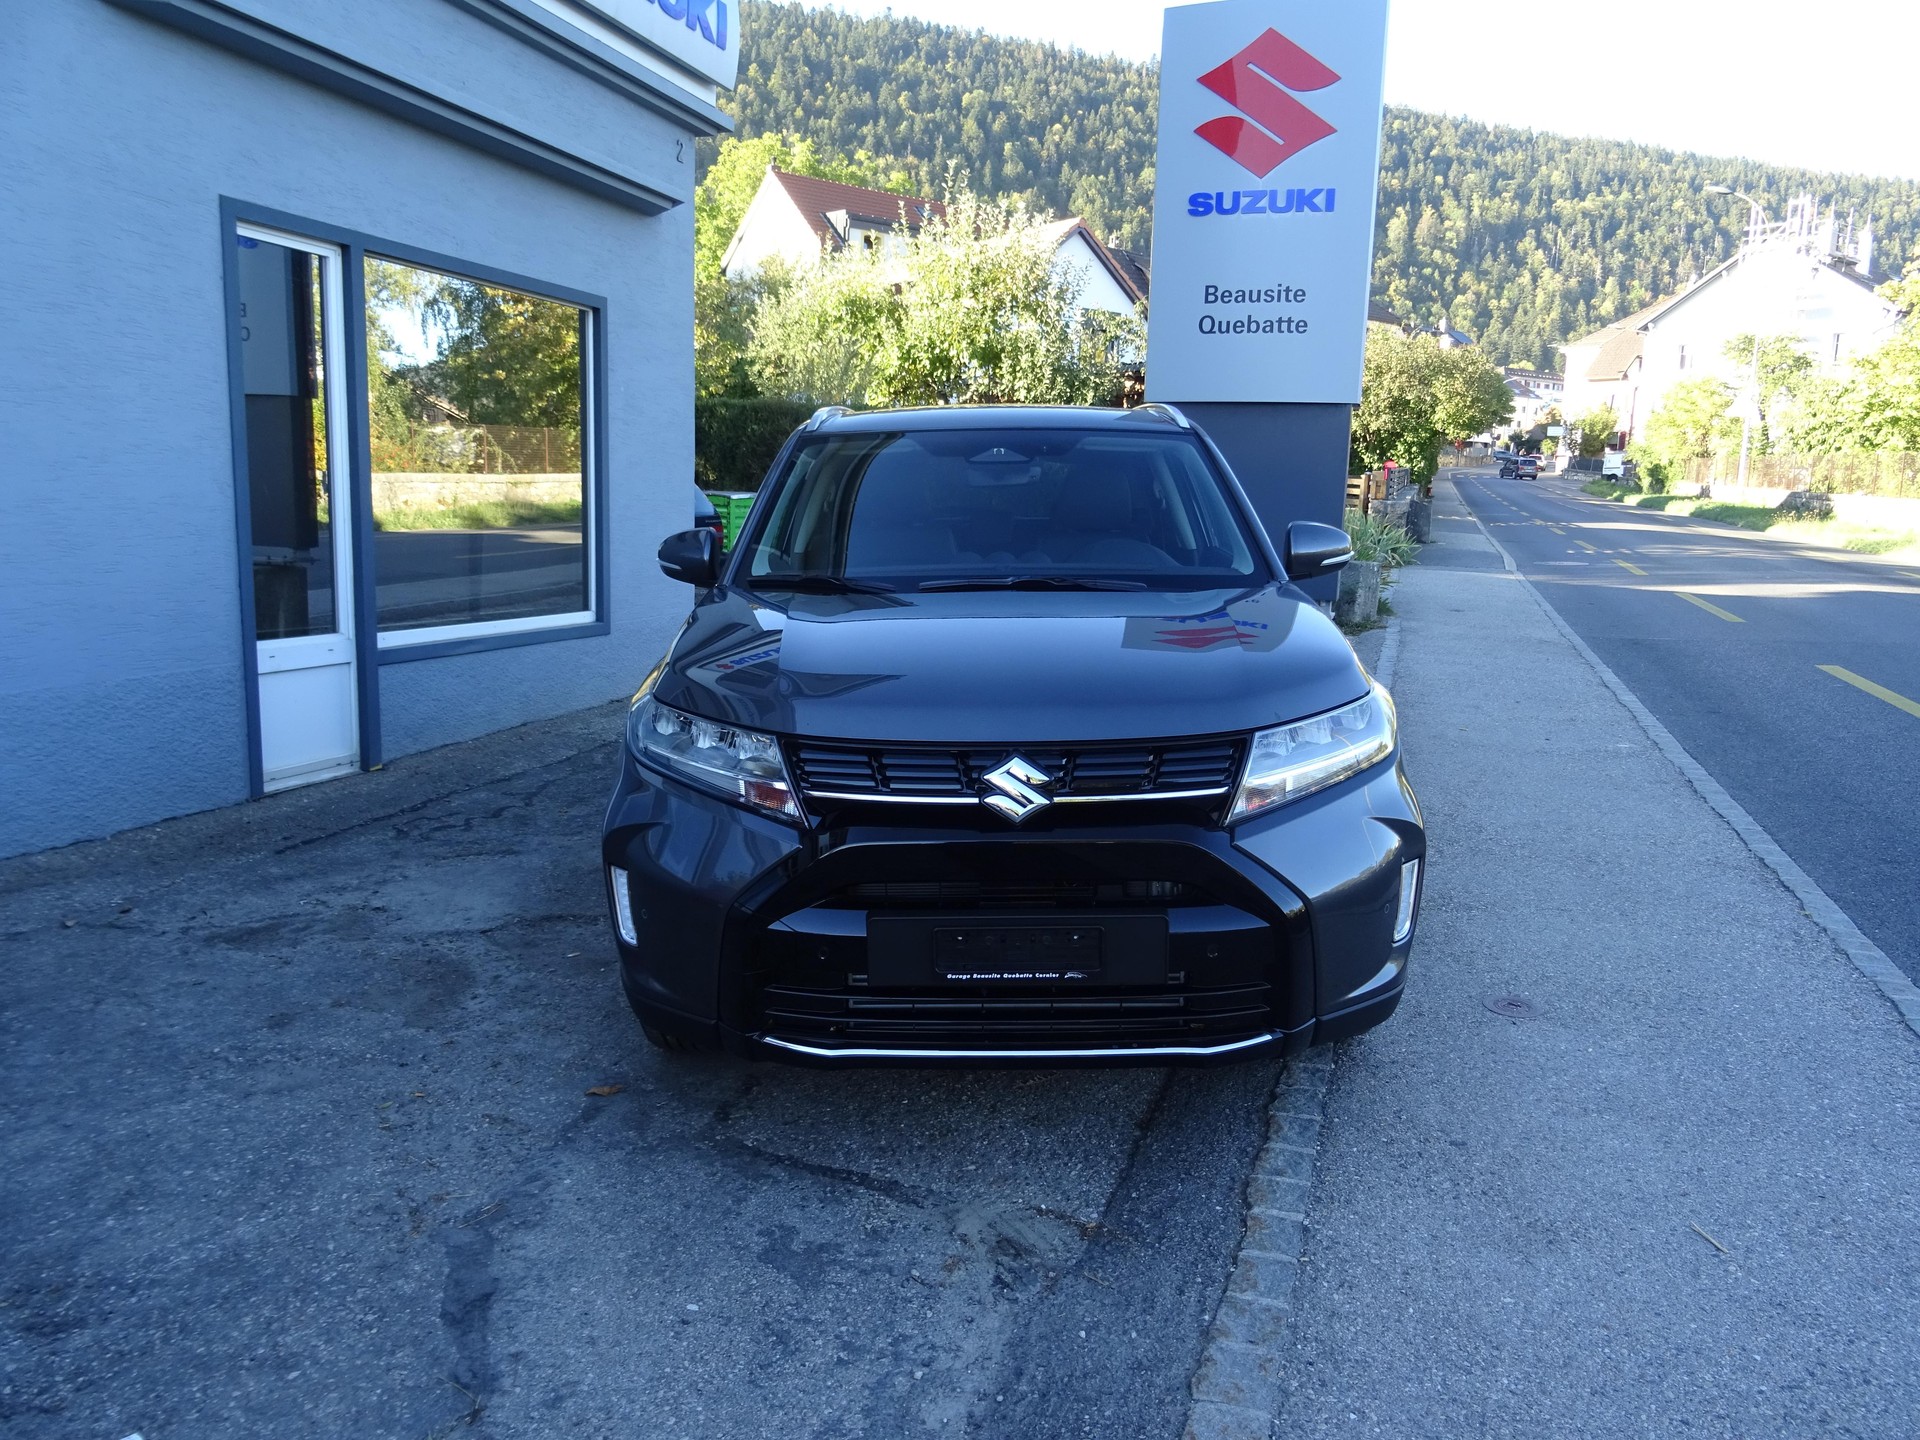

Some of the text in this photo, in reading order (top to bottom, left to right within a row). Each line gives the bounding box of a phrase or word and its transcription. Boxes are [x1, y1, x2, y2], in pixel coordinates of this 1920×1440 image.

[676, 139, 684, 164] 2
[1187, 188, 1336, 217] SUZUKI
[1203, 283, 1307, 305] Beausite
[1198, 314, 1309, 335] Quebatte
